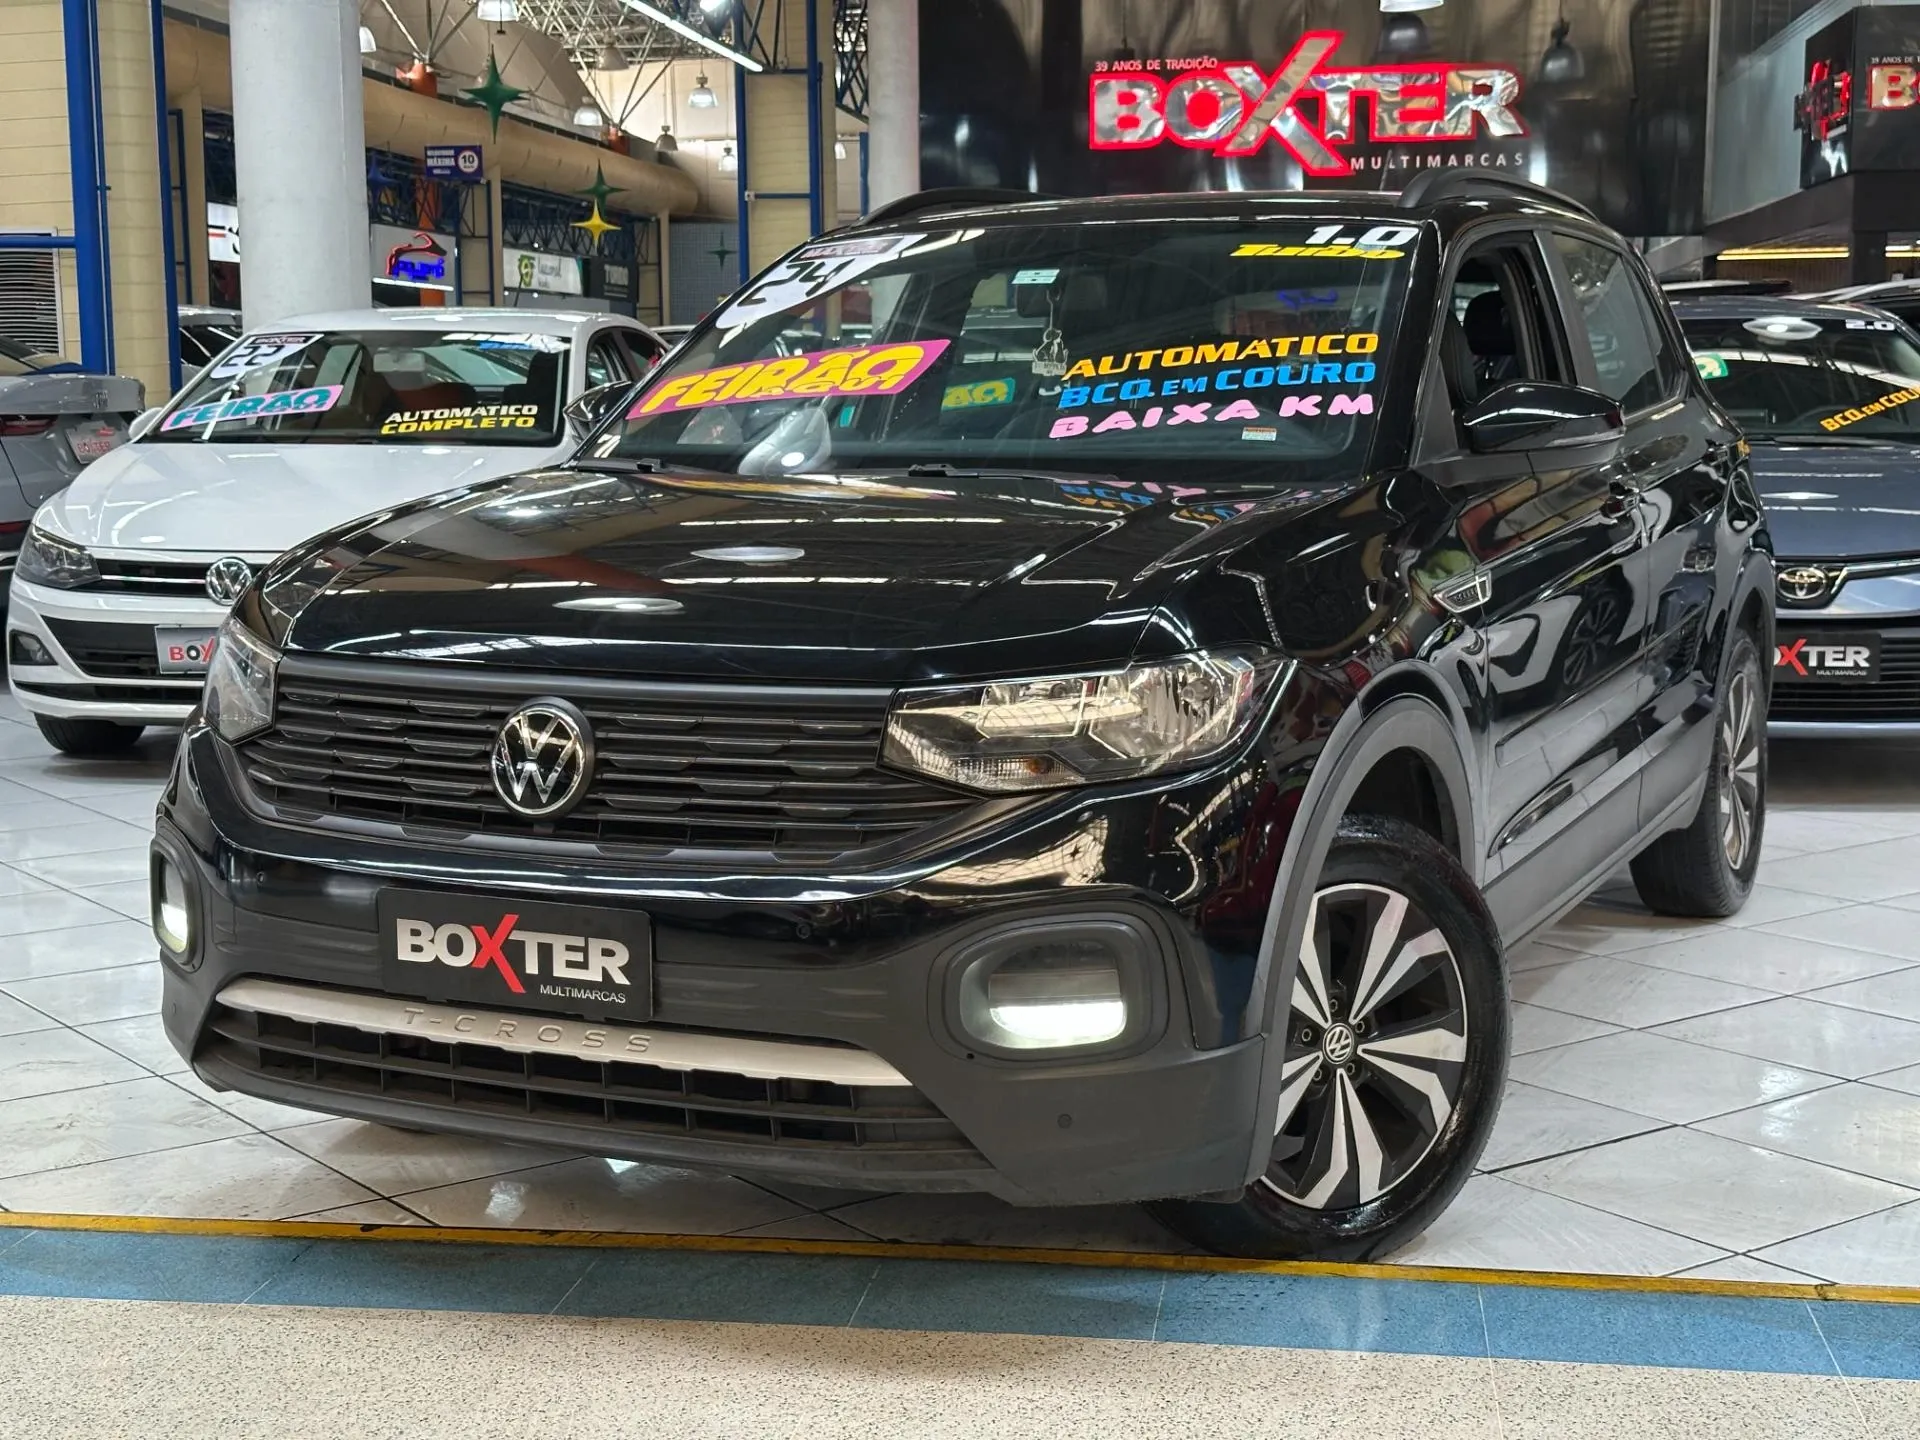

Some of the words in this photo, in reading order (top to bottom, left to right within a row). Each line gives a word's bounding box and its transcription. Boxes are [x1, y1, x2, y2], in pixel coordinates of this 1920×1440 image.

[1095, 60, 1109, 72] 39
[1112, 59, 1142, 71] ANOS
[1146, 59, 1161, 70] DE
[1165, 55, 1218, 70] TRADIÇÃO
[1866, 64, 1920, 111] B
[1089, 29, 1529, 175] BOXTER
[461, 154, 475, 165] 10
[1350, 153, 1523, 170] MULTIMARCAS
[1305, 225, 1419, 246] 1.0
[1845, 319, 1896, 331] 2.0
[640, 345, 924, 413] FEIRÃO
[1161, 375, 1208, 396] EM
[1215, 361, 1376, 391] COURO
[1049, 399, 1260, 439] BAIXA
[1278, 393, 1374, 417] KM
[1861, 401, 1886, 415] EM
[381, 417, 535, 435] COMPLETO
[396, 913, 631, 994] BOXTER
[539, 984, 626, 1004] MULTIMARCAS
[404, 1007, 652, 1053] T-CROSS
